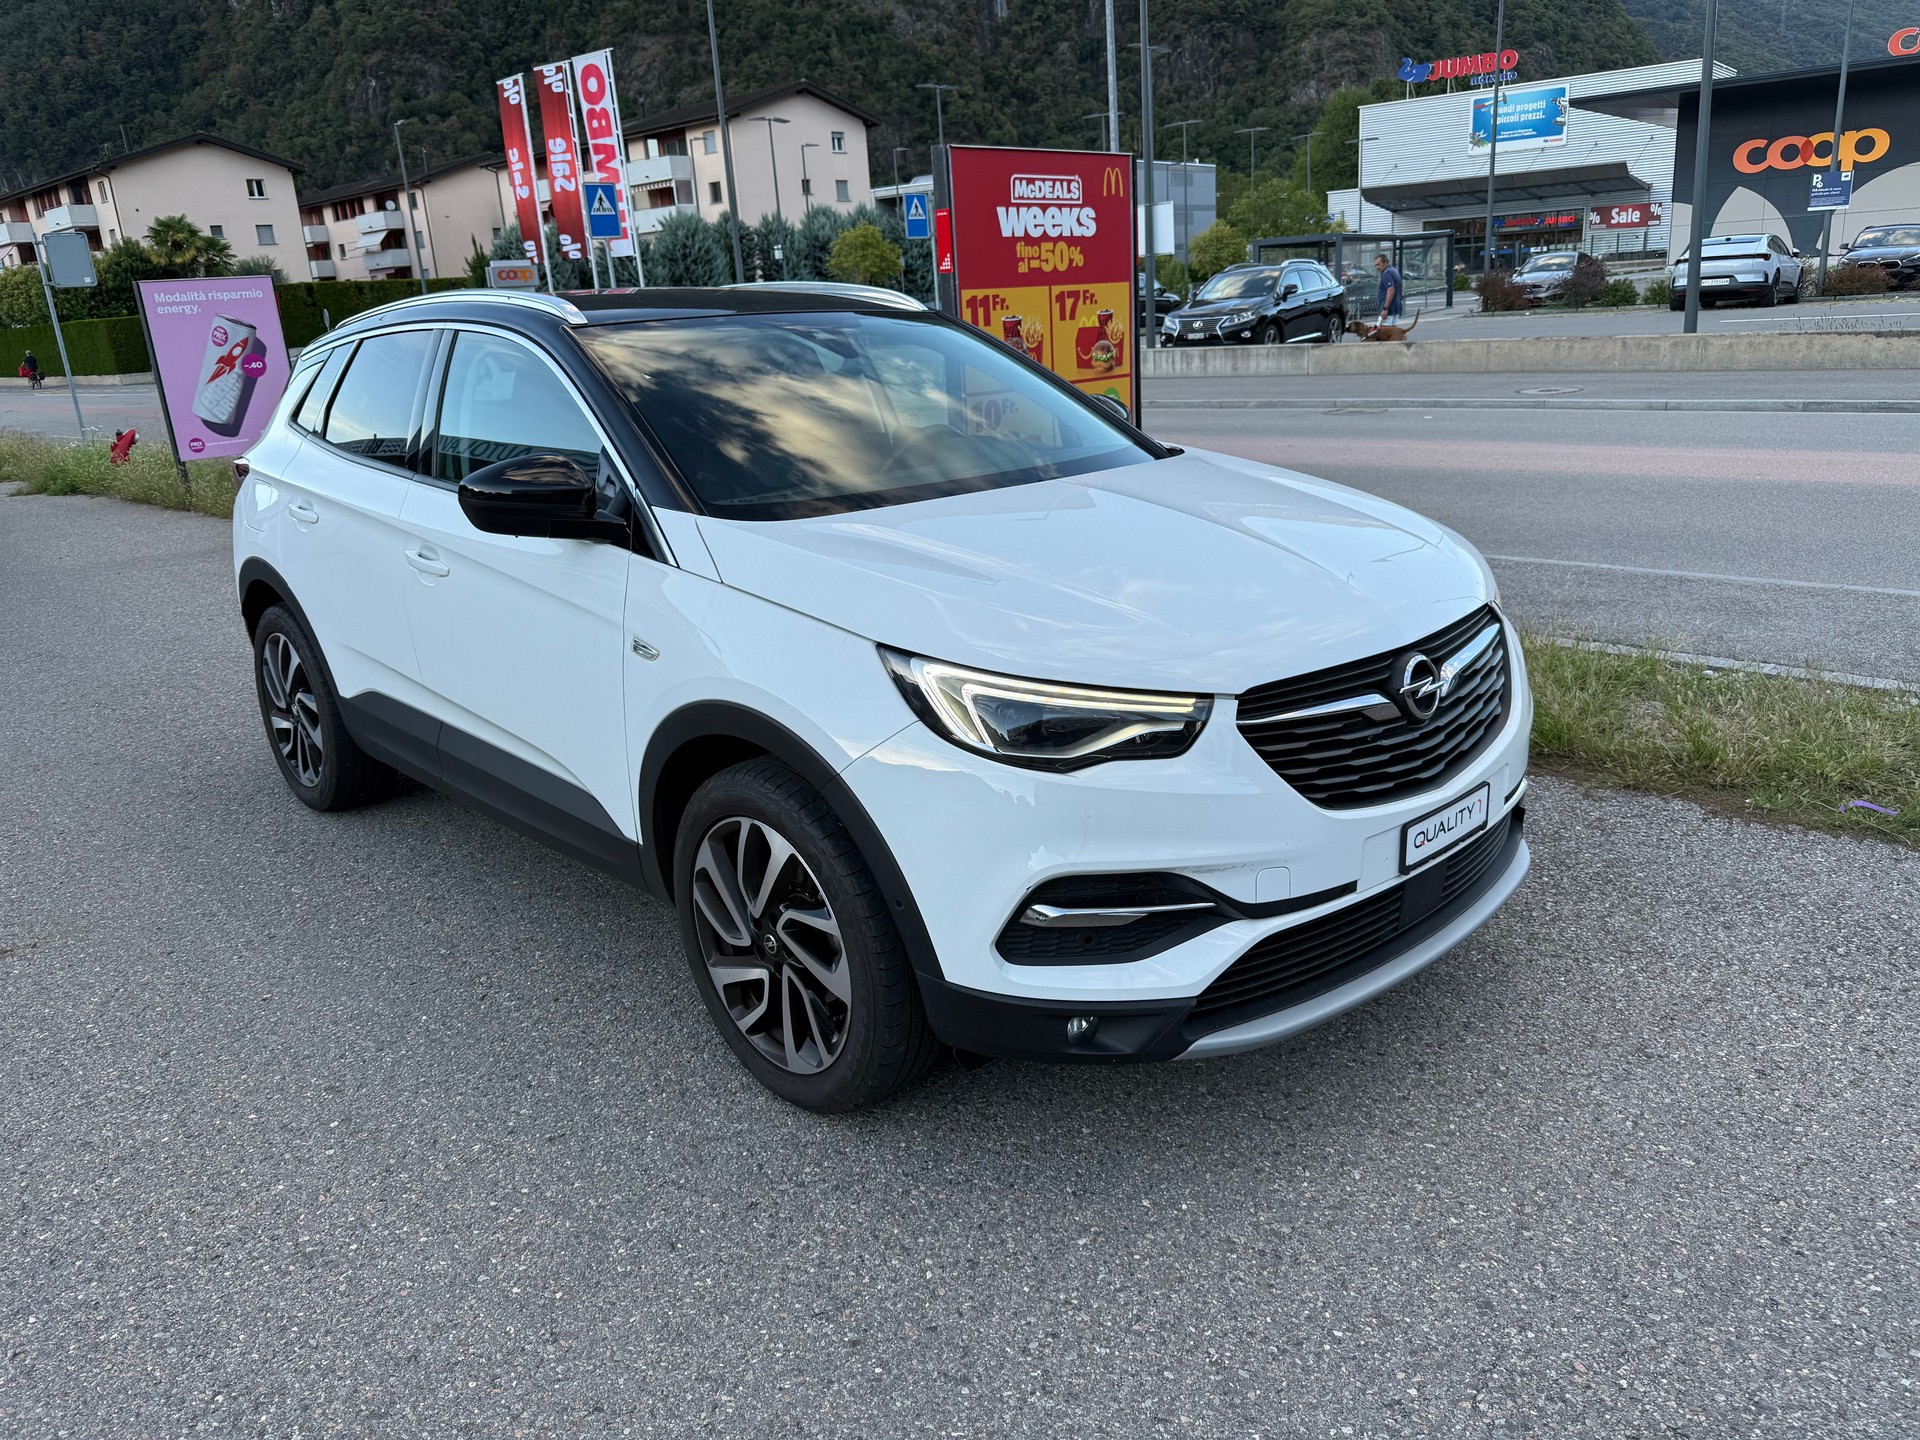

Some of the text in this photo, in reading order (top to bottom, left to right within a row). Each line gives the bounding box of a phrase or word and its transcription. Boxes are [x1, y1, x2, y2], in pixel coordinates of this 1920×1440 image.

[1428, 49, 1518, 81] JUMBO
[1516, 100, 1546, 112] progetti
[1732, 127, 1891, 174] coop
[1812, 173, 1822, 186] P
[1014, 180, 1080, 199] McDEALS
[1611, 208, 1640, 224] Sale
[1650, 203, 1662, 216] %
[1016, 241, 1039, 258] fino
[1018, 259, 1029, 273] al
[498, 269, 533, 282] coop
[154, 289, 263, 303] Modalità risparmio
[157, 304, 202, 314] energy.
[966, 294, 1010, 327] 11 Fr.
[1055, 290, 1098, 321] 17 Fr.
[1414, 799, 1482, 849] QUALITY 1
